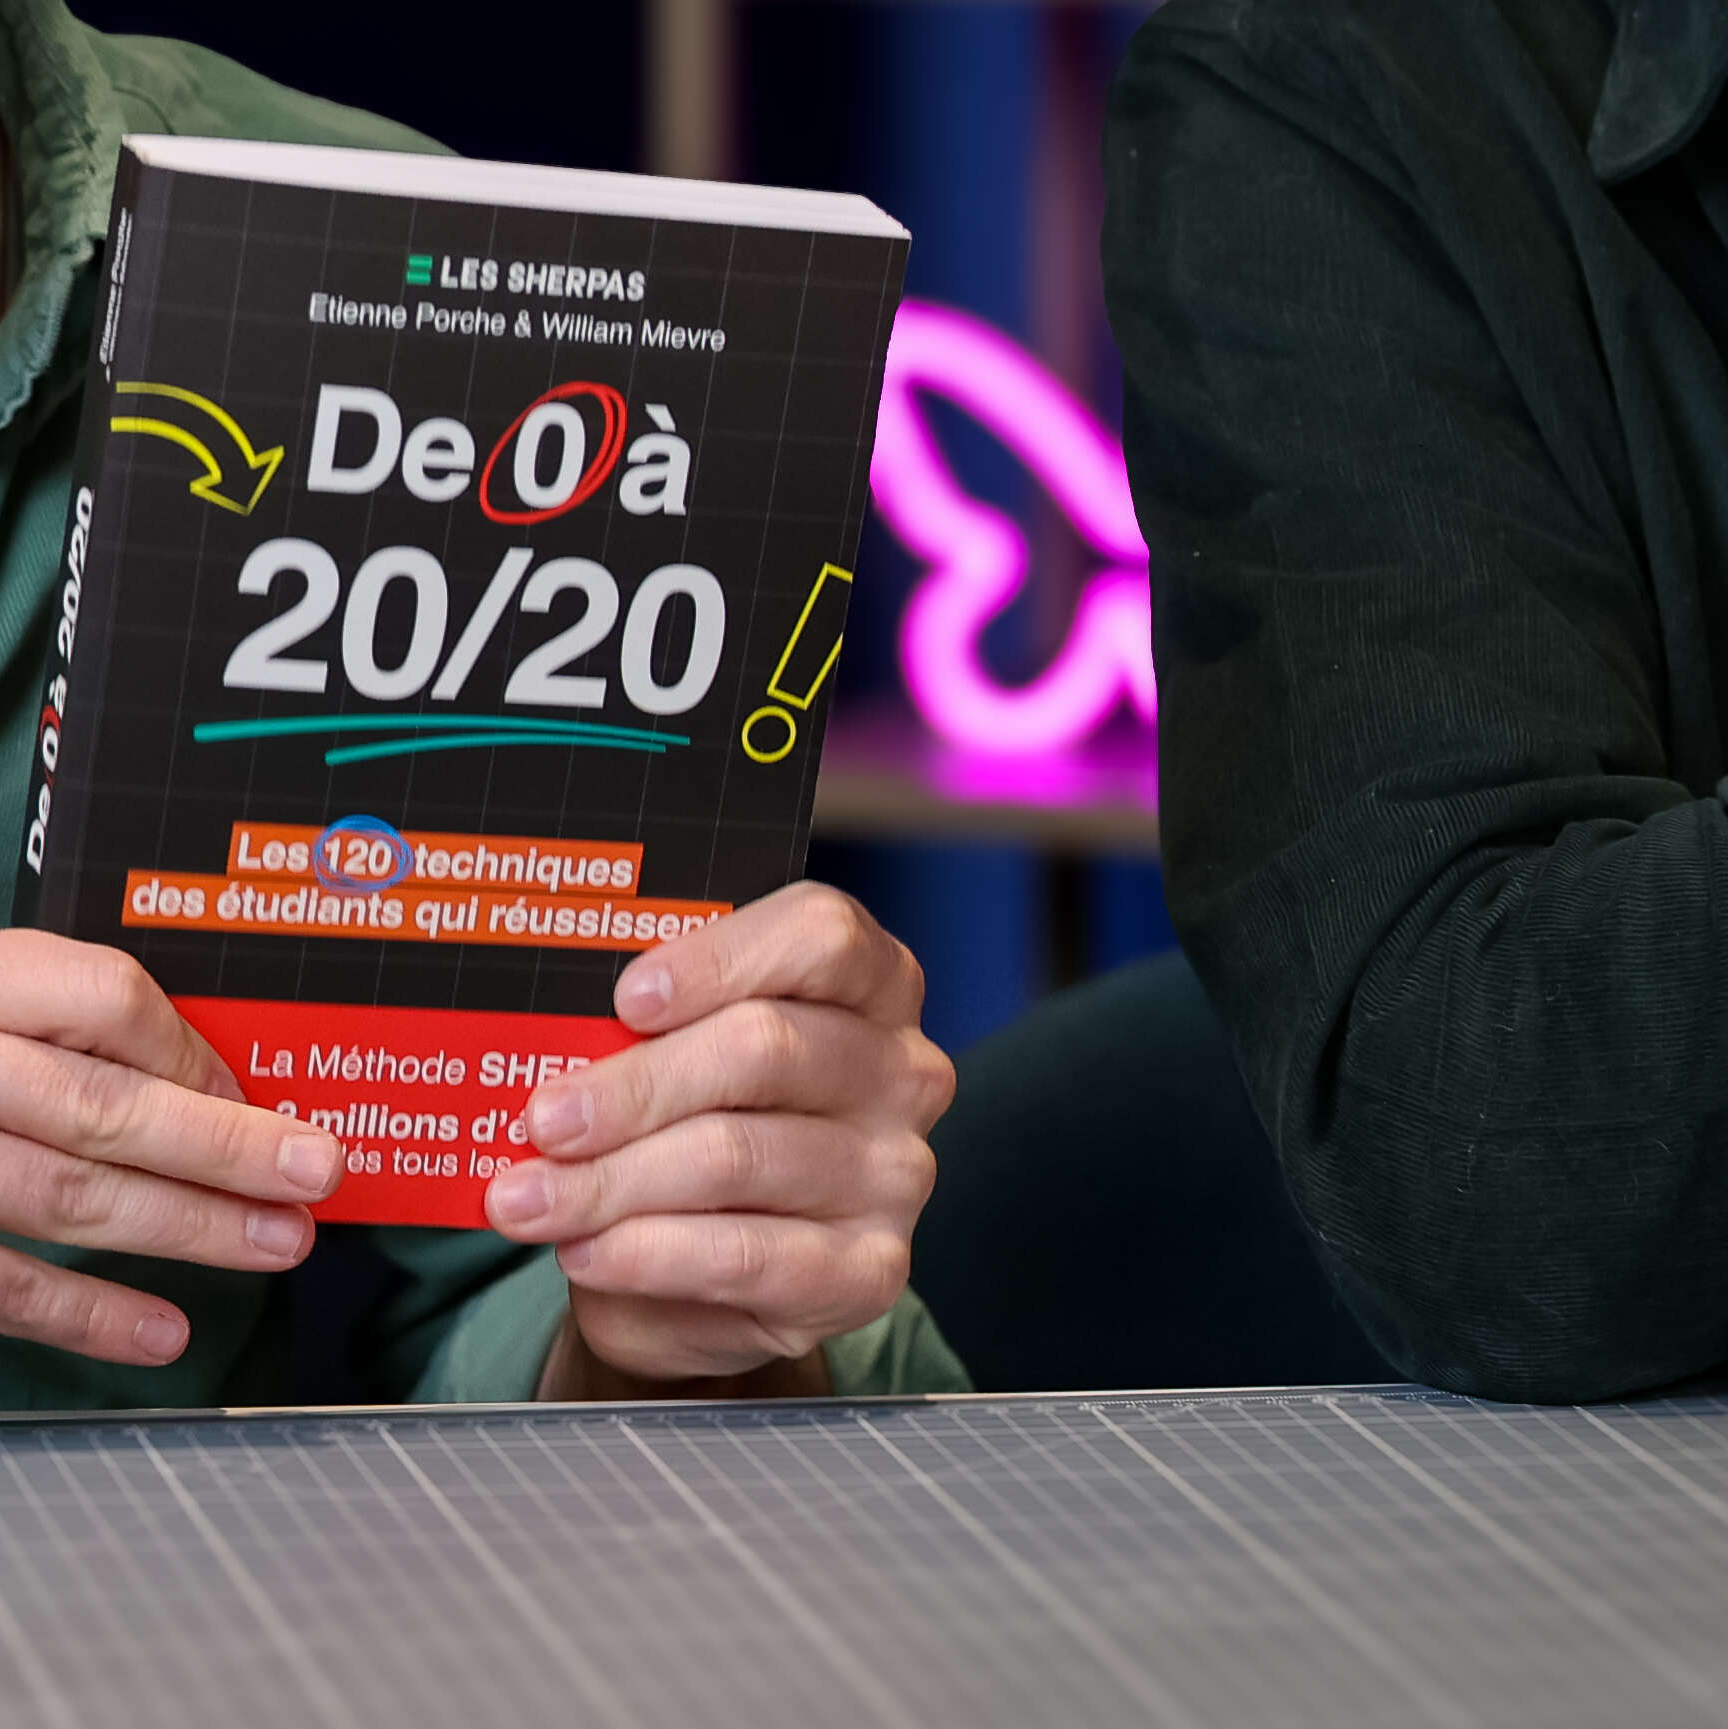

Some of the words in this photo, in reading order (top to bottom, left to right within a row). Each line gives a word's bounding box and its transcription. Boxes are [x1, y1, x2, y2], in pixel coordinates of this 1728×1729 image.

[441, 255, 500, 290] LES
[507, 262, 645, 302] SHERPAS
[309, 292, 406, 329] Etienne
[416, 302, 505, 337] Porche
[514, 310, 532, 339] &
[542, 312, 632, 347] William
[641, 318, 726, 354] Mievre
[307, 384, 474, 503] De
[514, 403, 587, 509] 0
[618, 405, 692, 515] à
[222, 536, 727, 716] 20/20
[27, 782, 51, 875] De
[58, 485, 95, 664] 20/20
[239, 830, 309, 876] Les
[324, 835, 393, 882] 120
[414, 847, 635, 890] techniques
[131, 878, 205, 919] des
[217, 882, 403, 929] étudiants
[414, 898, 477, 943] qui
[250, 1041, 294, 1078] La
[307, 1043, 466, 1086] Méthode
[309, 1102, 459, 1142] millions
[393, 1146, 458, 1178] tous
[469, 1148, 512, 1179] les
